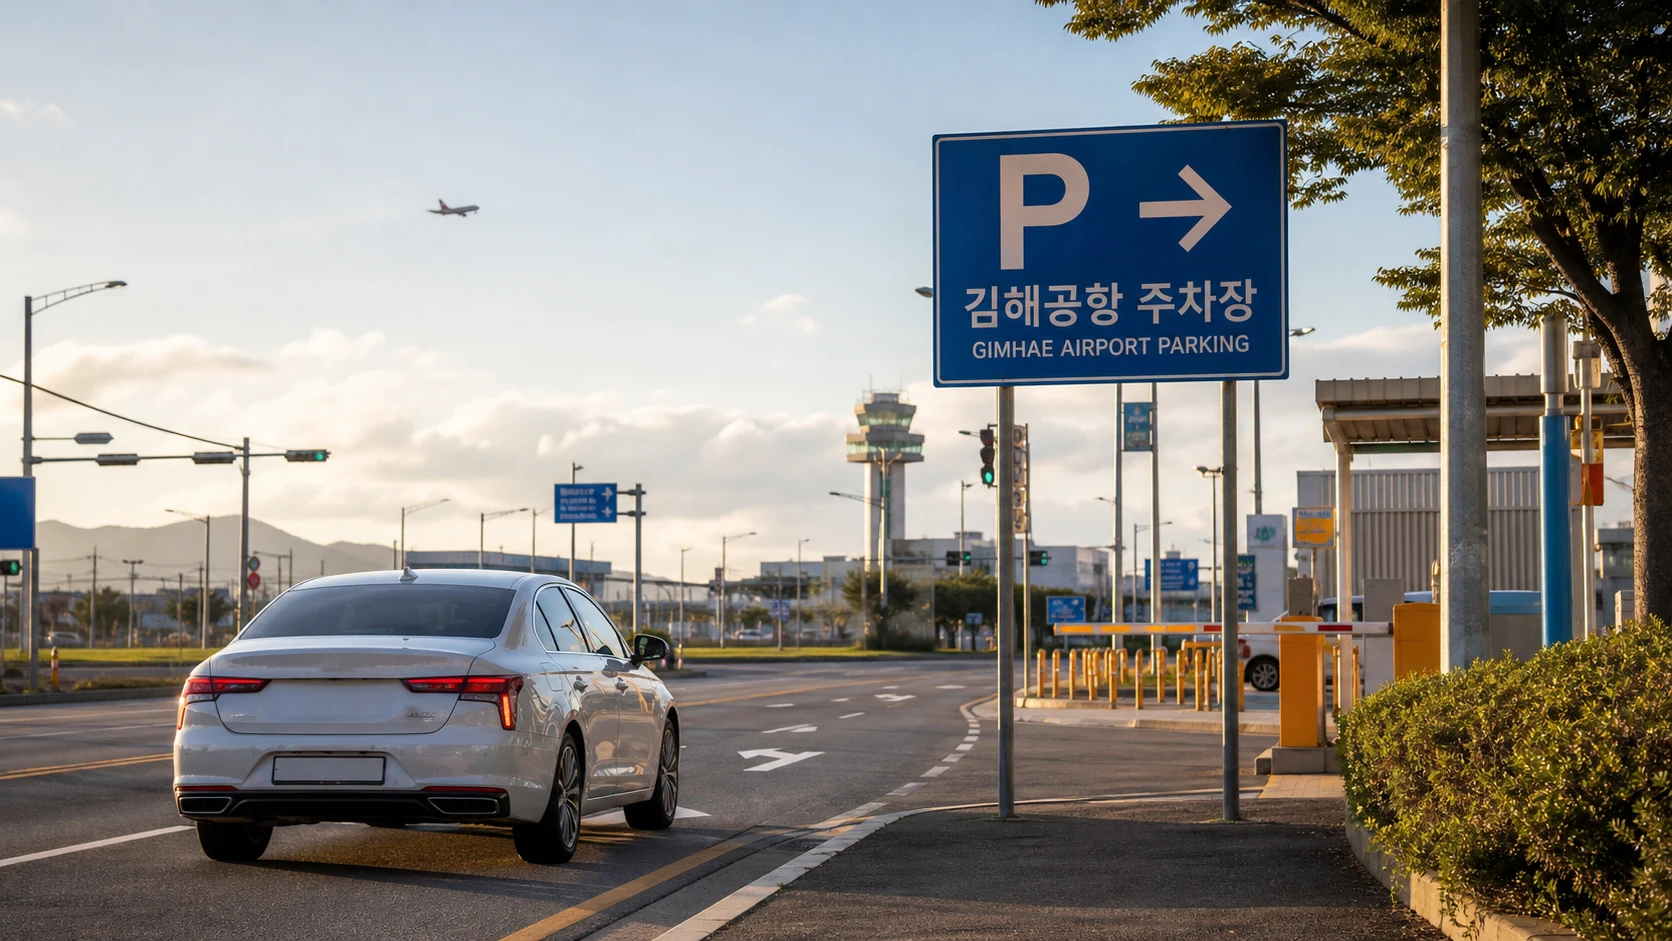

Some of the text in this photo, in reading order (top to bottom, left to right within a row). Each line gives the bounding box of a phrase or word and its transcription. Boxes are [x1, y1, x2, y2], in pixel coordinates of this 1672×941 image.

[1000, 153, 1089, 270] P
[965, 279, 1257, 328] 김해공항 주차장
[973, 335, 1248, 358] GIMHAE AIRPORT PARKING
